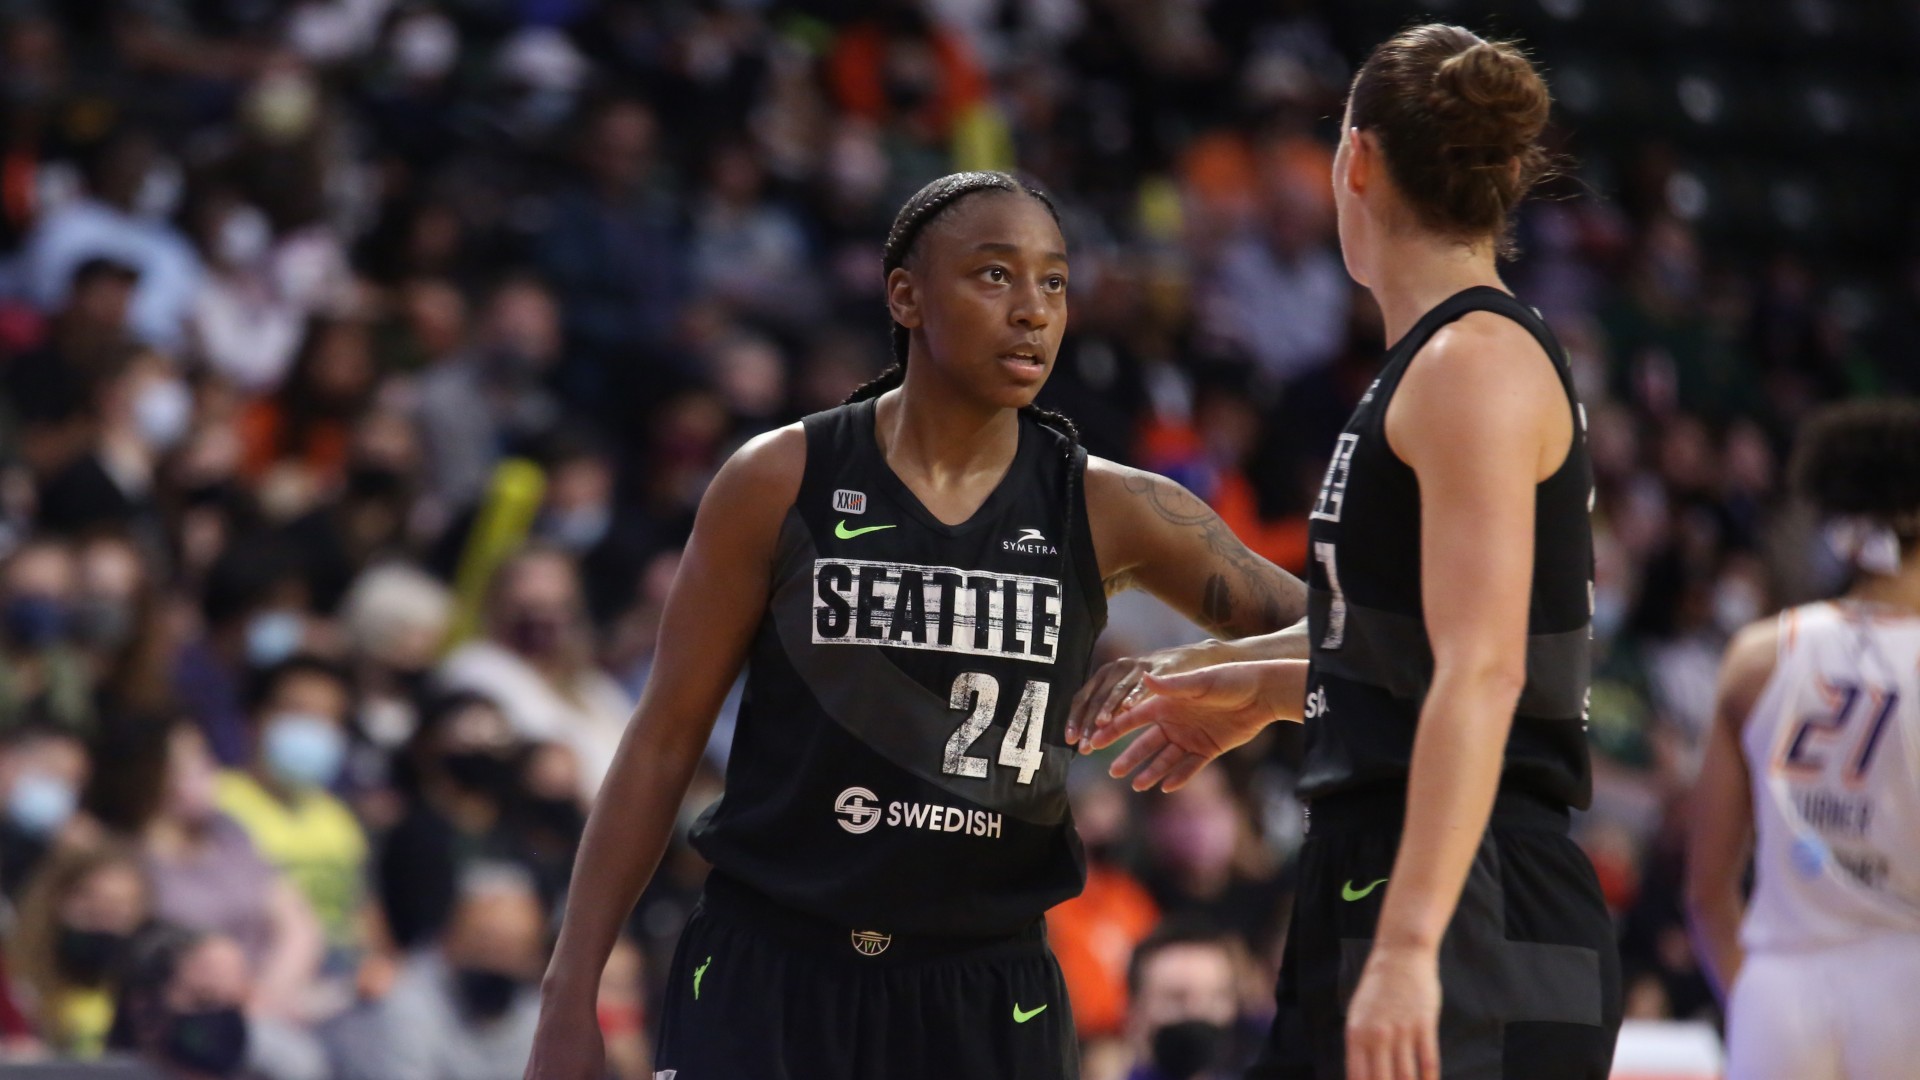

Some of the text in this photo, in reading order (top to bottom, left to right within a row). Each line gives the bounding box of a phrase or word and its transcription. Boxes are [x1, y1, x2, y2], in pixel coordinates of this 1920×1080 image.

[1003, 540, 1058, 555] SYMETRA
[814, 561, 1061, 661] SEATTLE
[942, 671, 1051, 785] 24
[1772, 676, 1899, 788] 21
[886, 801, 1002, 839] SWEDISH
